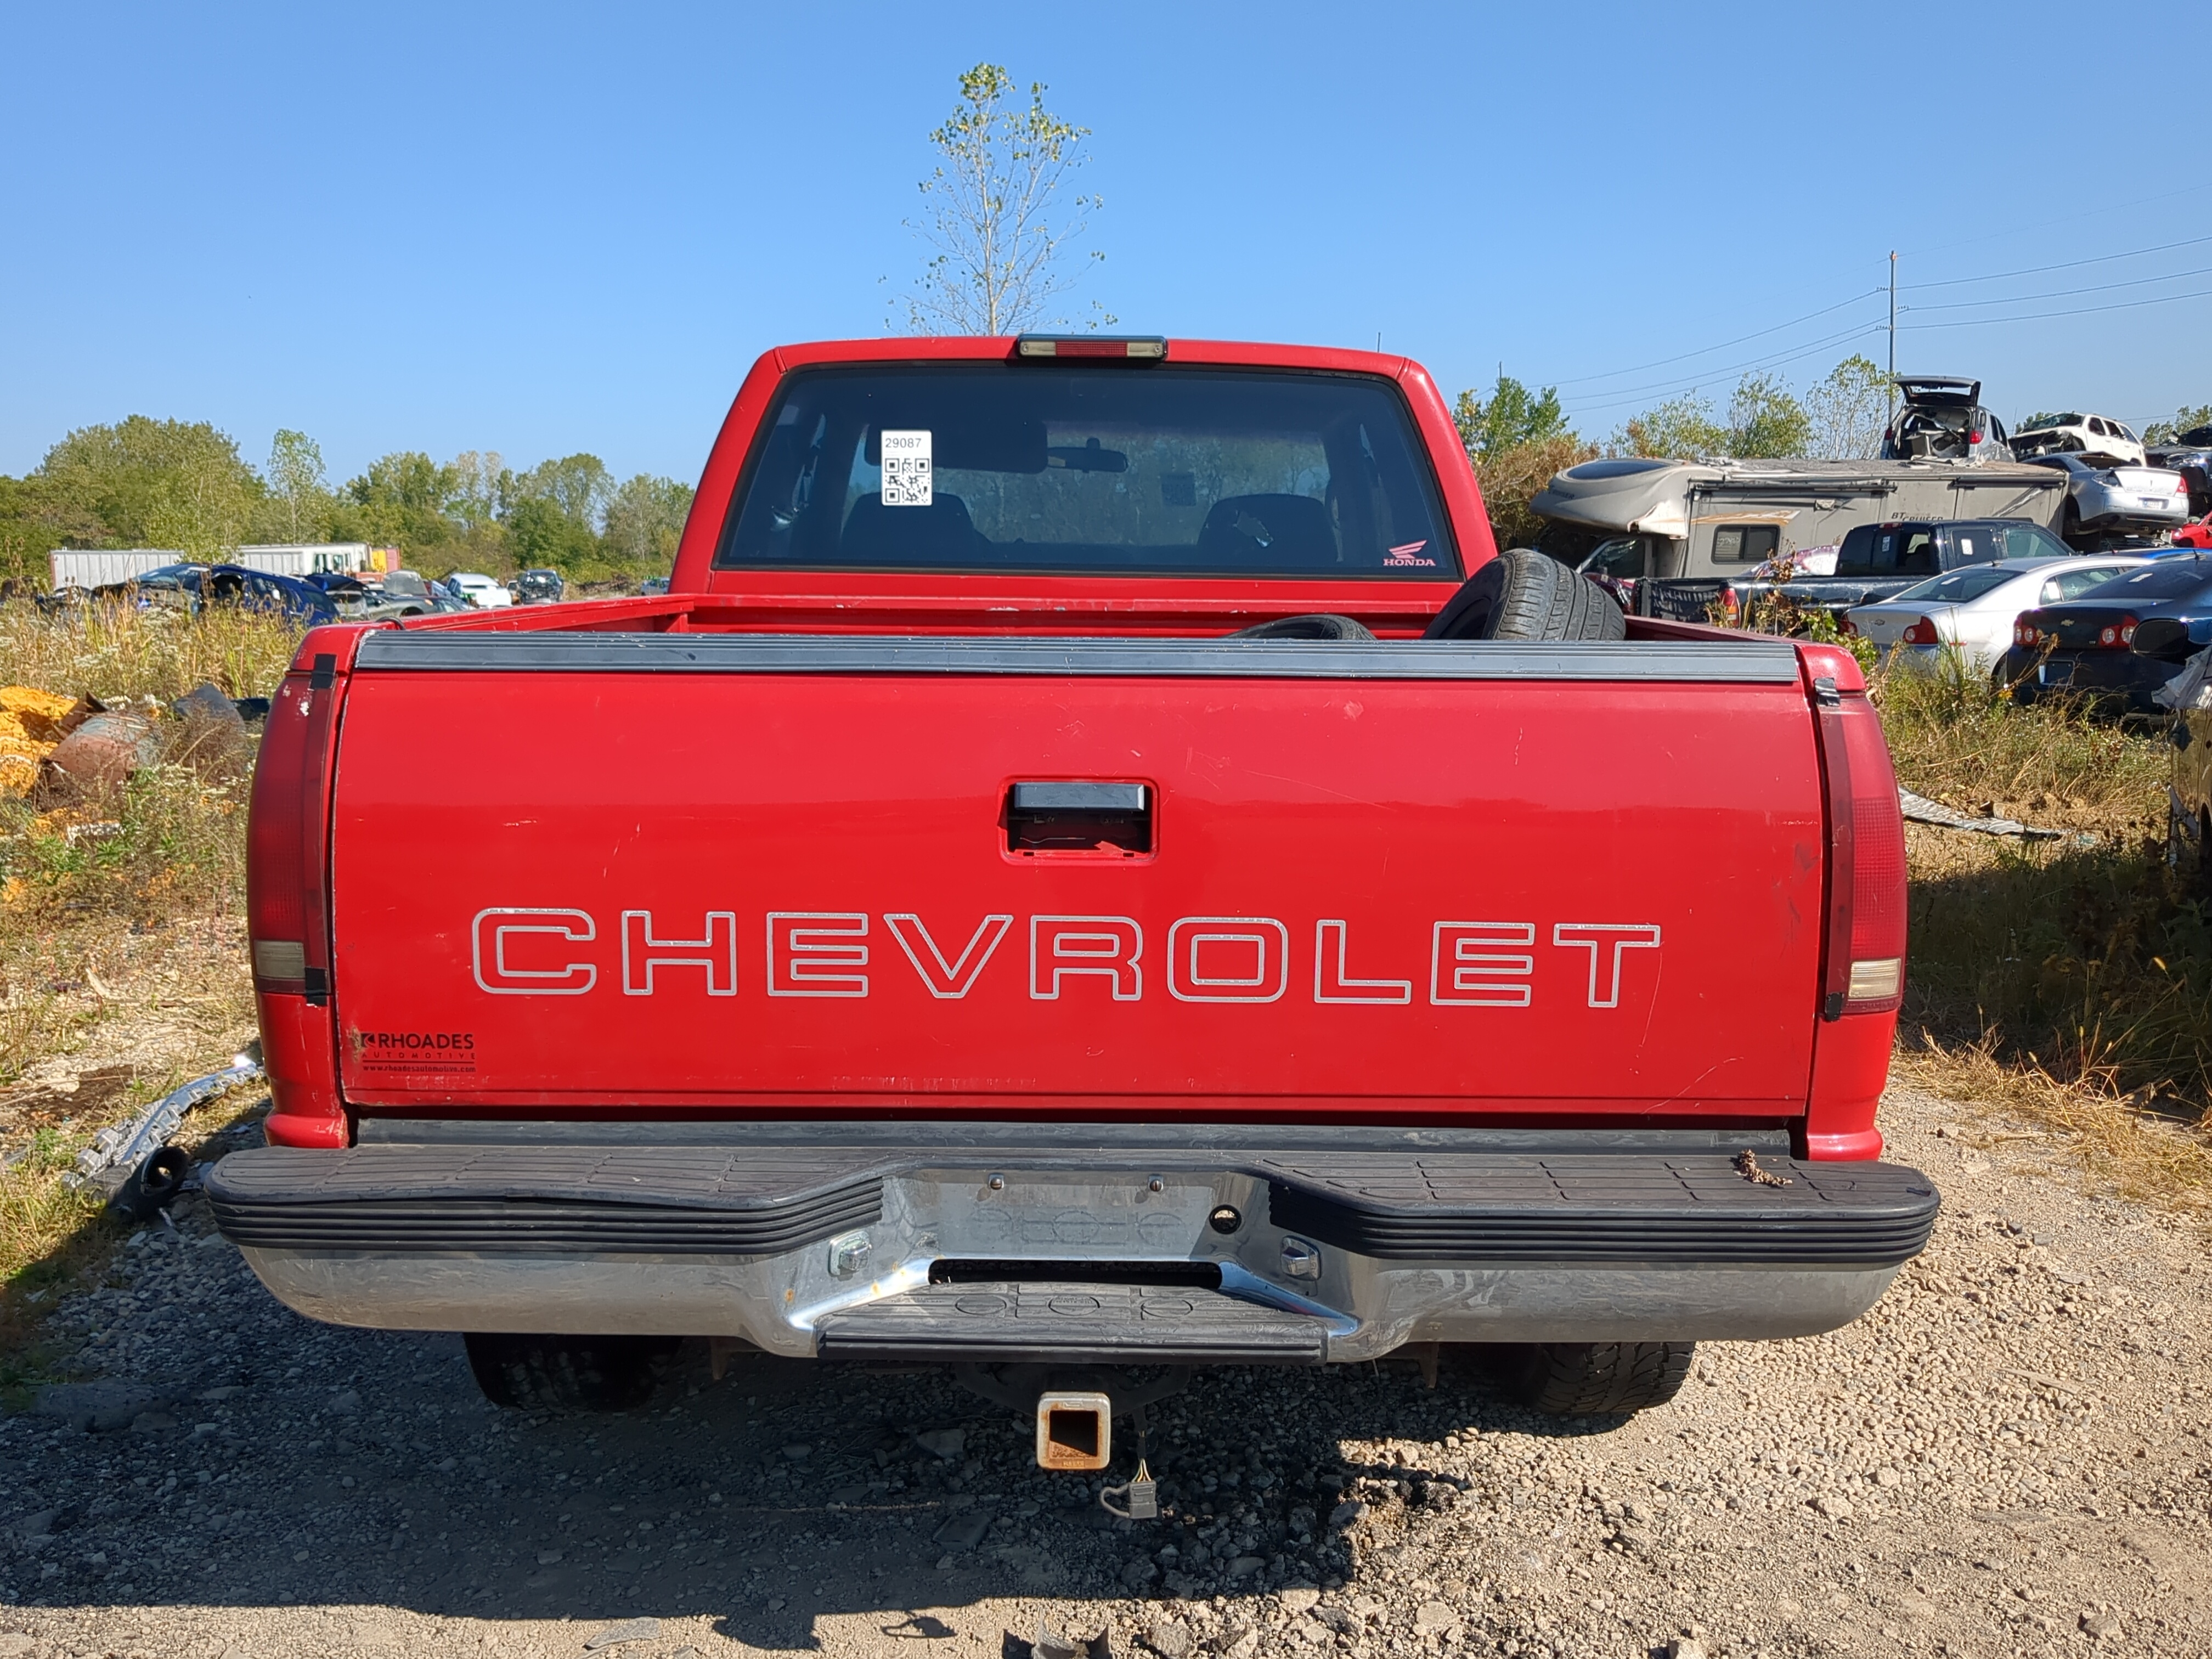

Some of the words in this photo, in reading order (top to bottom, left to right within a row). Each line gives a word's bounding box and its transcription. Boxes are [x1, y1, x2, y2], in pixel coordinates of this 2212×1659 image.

[885, 438, 922, 448] 29087
[472, 908, 1661, 1008] CHEVROLET
[378, 1033, 474, 1049] RHOADES
